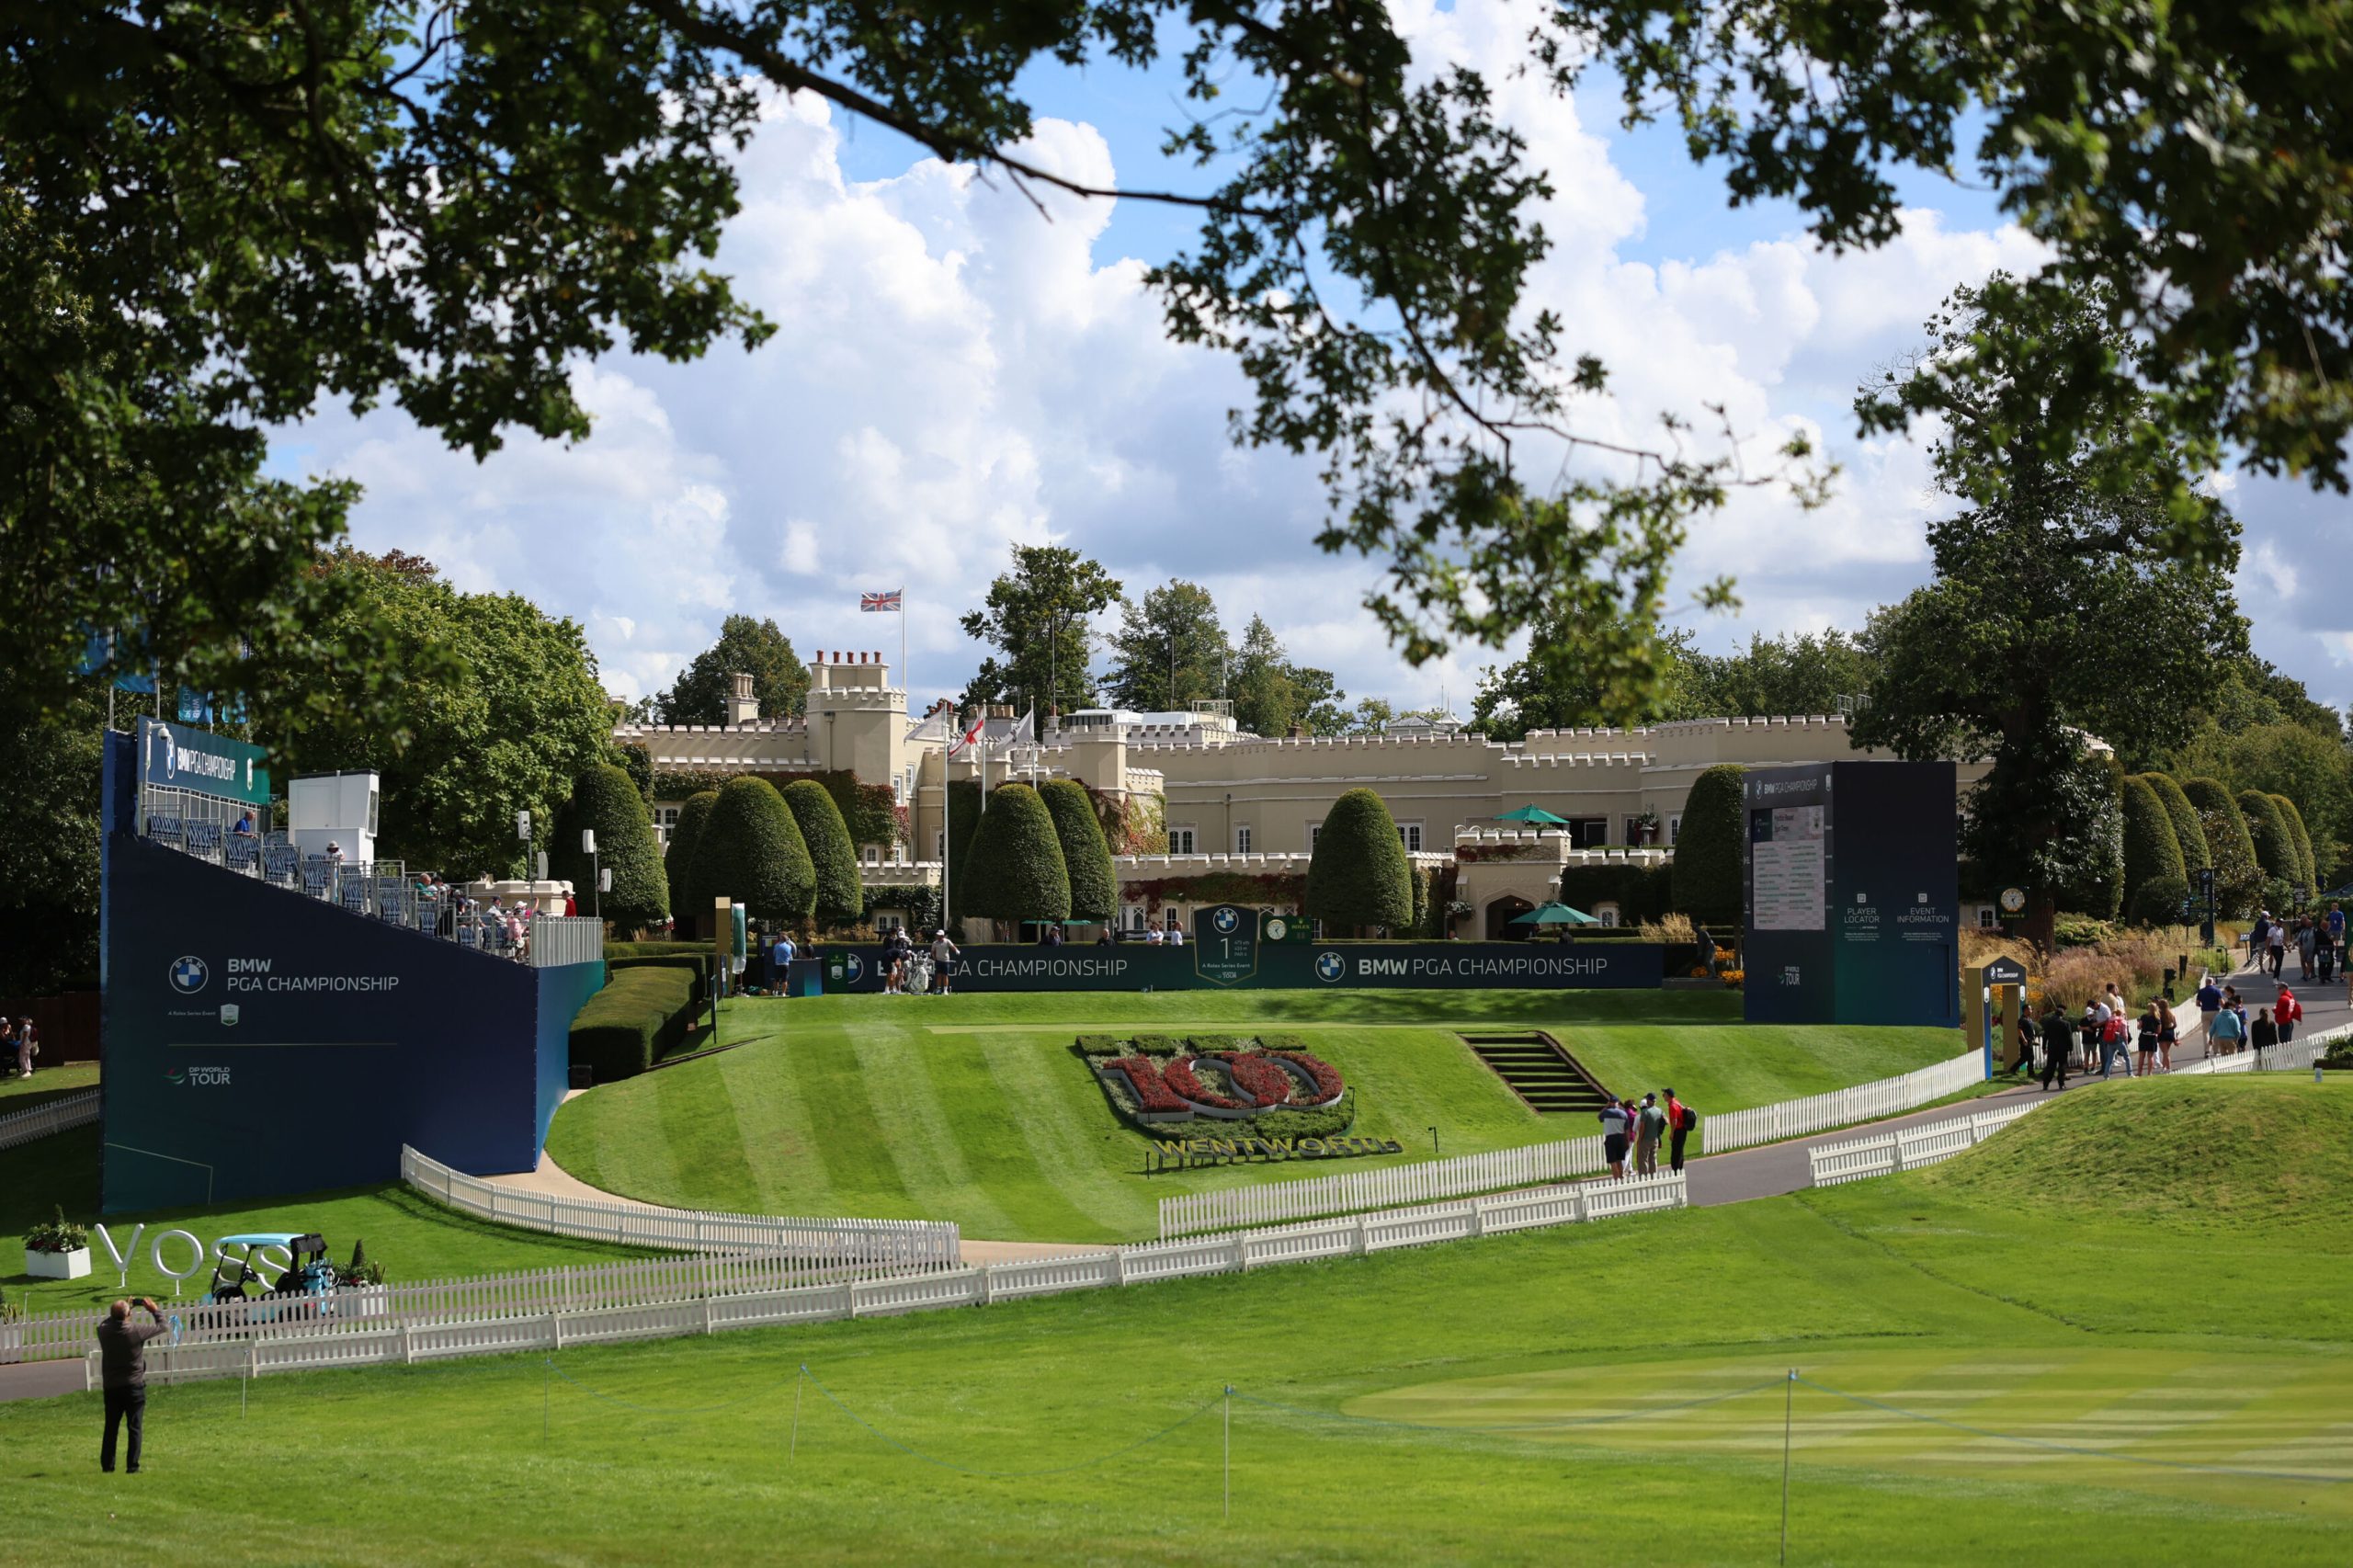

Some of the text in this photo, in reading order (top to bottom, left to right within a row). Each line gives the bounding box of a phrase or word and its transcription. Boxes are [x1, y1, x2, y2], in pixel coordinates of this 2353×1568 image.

[176, 746, 190, 772] BMW
[189, 750, 201, 774] PGA
[1847, 907, 1877, 915] PLAYER
[1910, 907, 1936, 915] EVENT
[1220, 937, 1229, 960] 1
[227, 959, 272, 972] BMW
[977, 960, 1128, 976] CHAMPIONSHIP
[1358, 959, 1608, 975] BMW PGA CHAMPIONSHIP
[227, 976, 399, 992] PGA CHAMPIONSHIP
[1784, 973, 1801, 986] TOUR
[189, 1073, 231, 1085] TOUR
[1153, 1135, 1404, 1161] WENTWORTH
